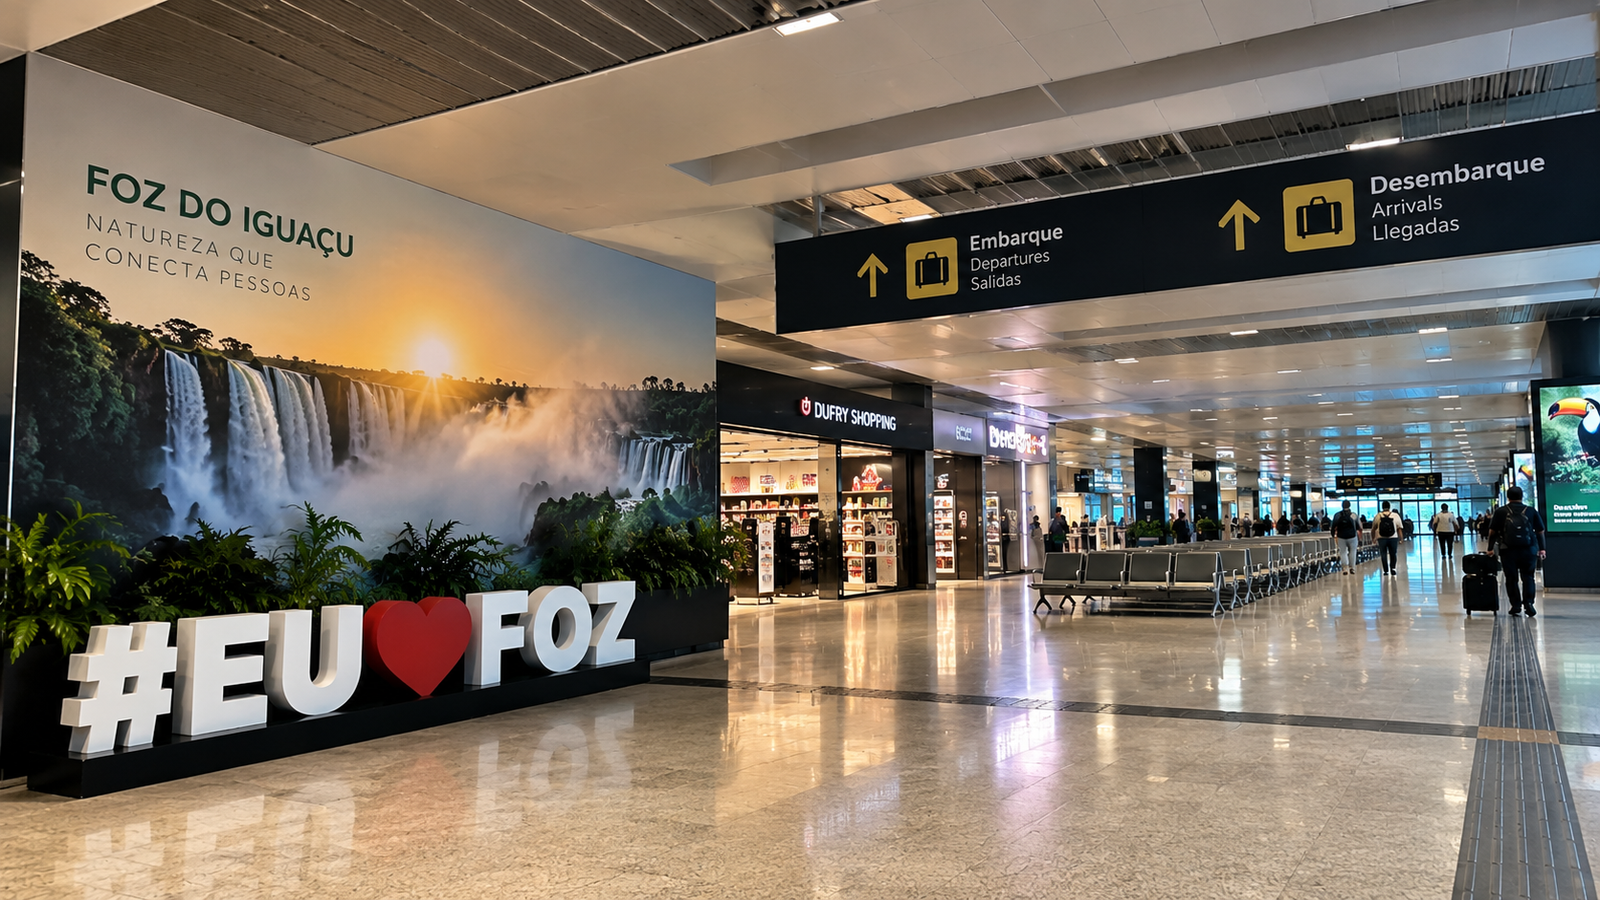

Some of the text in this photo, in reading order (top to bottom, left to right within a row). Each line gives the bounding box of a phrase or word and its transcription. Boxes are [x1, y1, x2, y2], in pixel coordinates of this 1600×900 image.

[1370, 154, 1546, 196] Desembarque
[87, 164, 354, 259] FOZ DO IGUAÇU
[1371, 193, 1443, 218] Arrivals
[86, 213, 273, 269] NATUREZA QUE
[969, 224, 1064, 251] Embarque
[1372, 216, 1460, 243] Llegadas
[85, 243, 311, 301] CONECTA PESSOAS
[970, 249, 1051, 272] Departures
[970, 270, 1021, 291] Salidas
[814, 401, 897, 431] DUFRY SHOPPING
[60, 580, 636, 754] #EU FOZ
